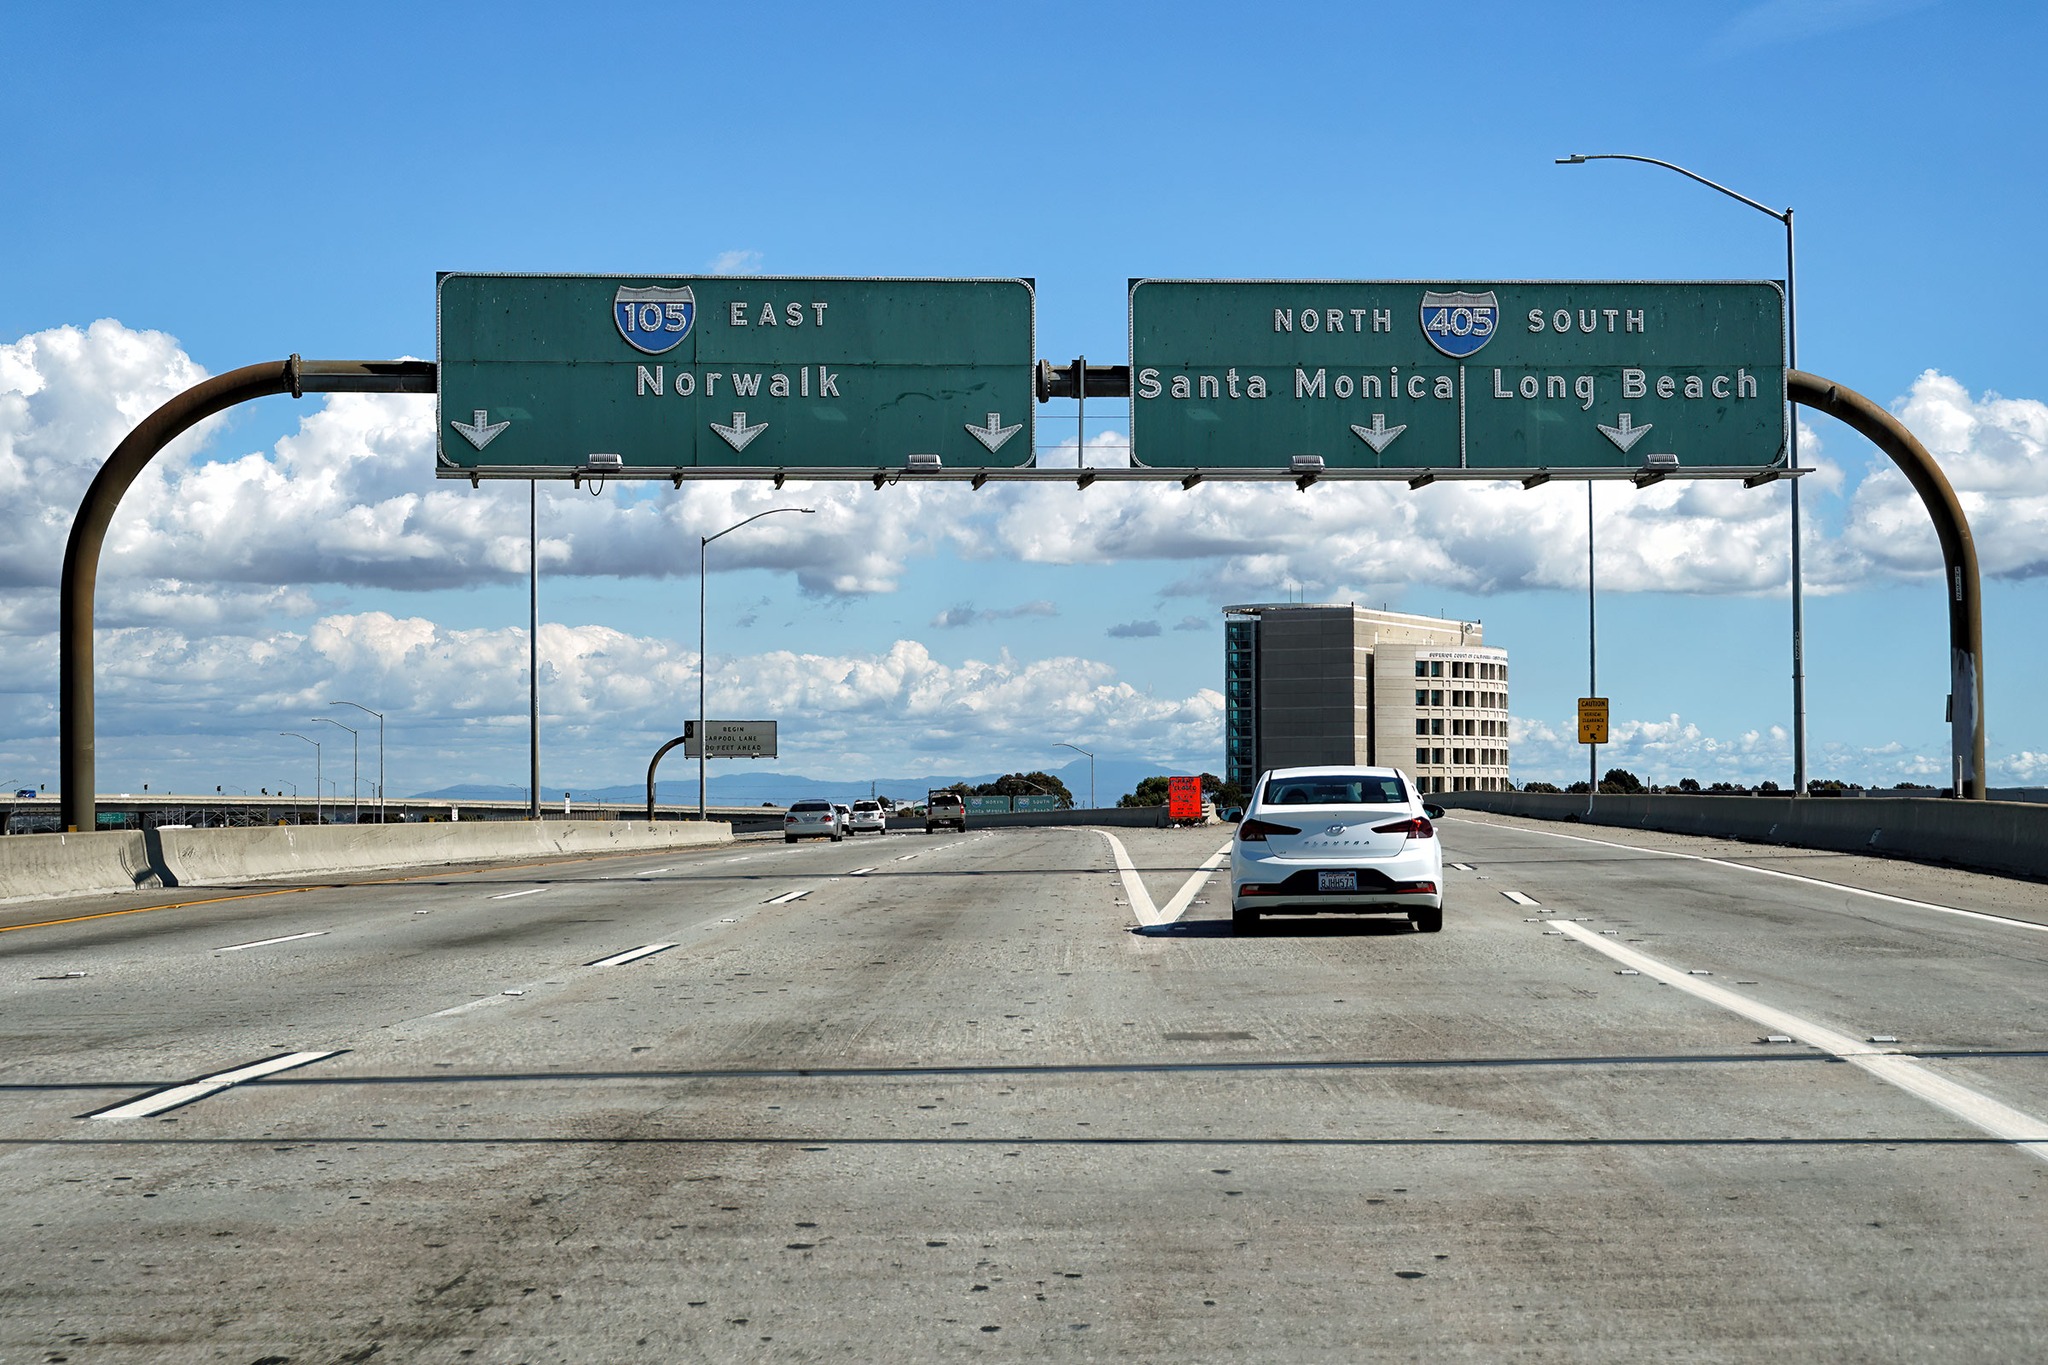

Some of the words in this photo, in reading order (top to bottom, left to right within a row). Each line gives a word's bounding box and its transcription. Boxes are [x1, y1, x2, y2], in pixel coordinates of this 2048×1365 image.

[624, 302, 687, 332] 105
[730, 302, 828, 326] EAST
[1274, 308, 1391, 332] NORTH
[1427, 307, 1494, 336] 405
[1528, 308, 1644, 332] SOUTH
[637, 365, 841, 397] Norwalk
[1138, 367, 1267, 399] Santa
[1294, 366, 1454, 399] Monica
[1493, 367, 1595, 411] Long
[1621, 367, 1758, 399] Beach
